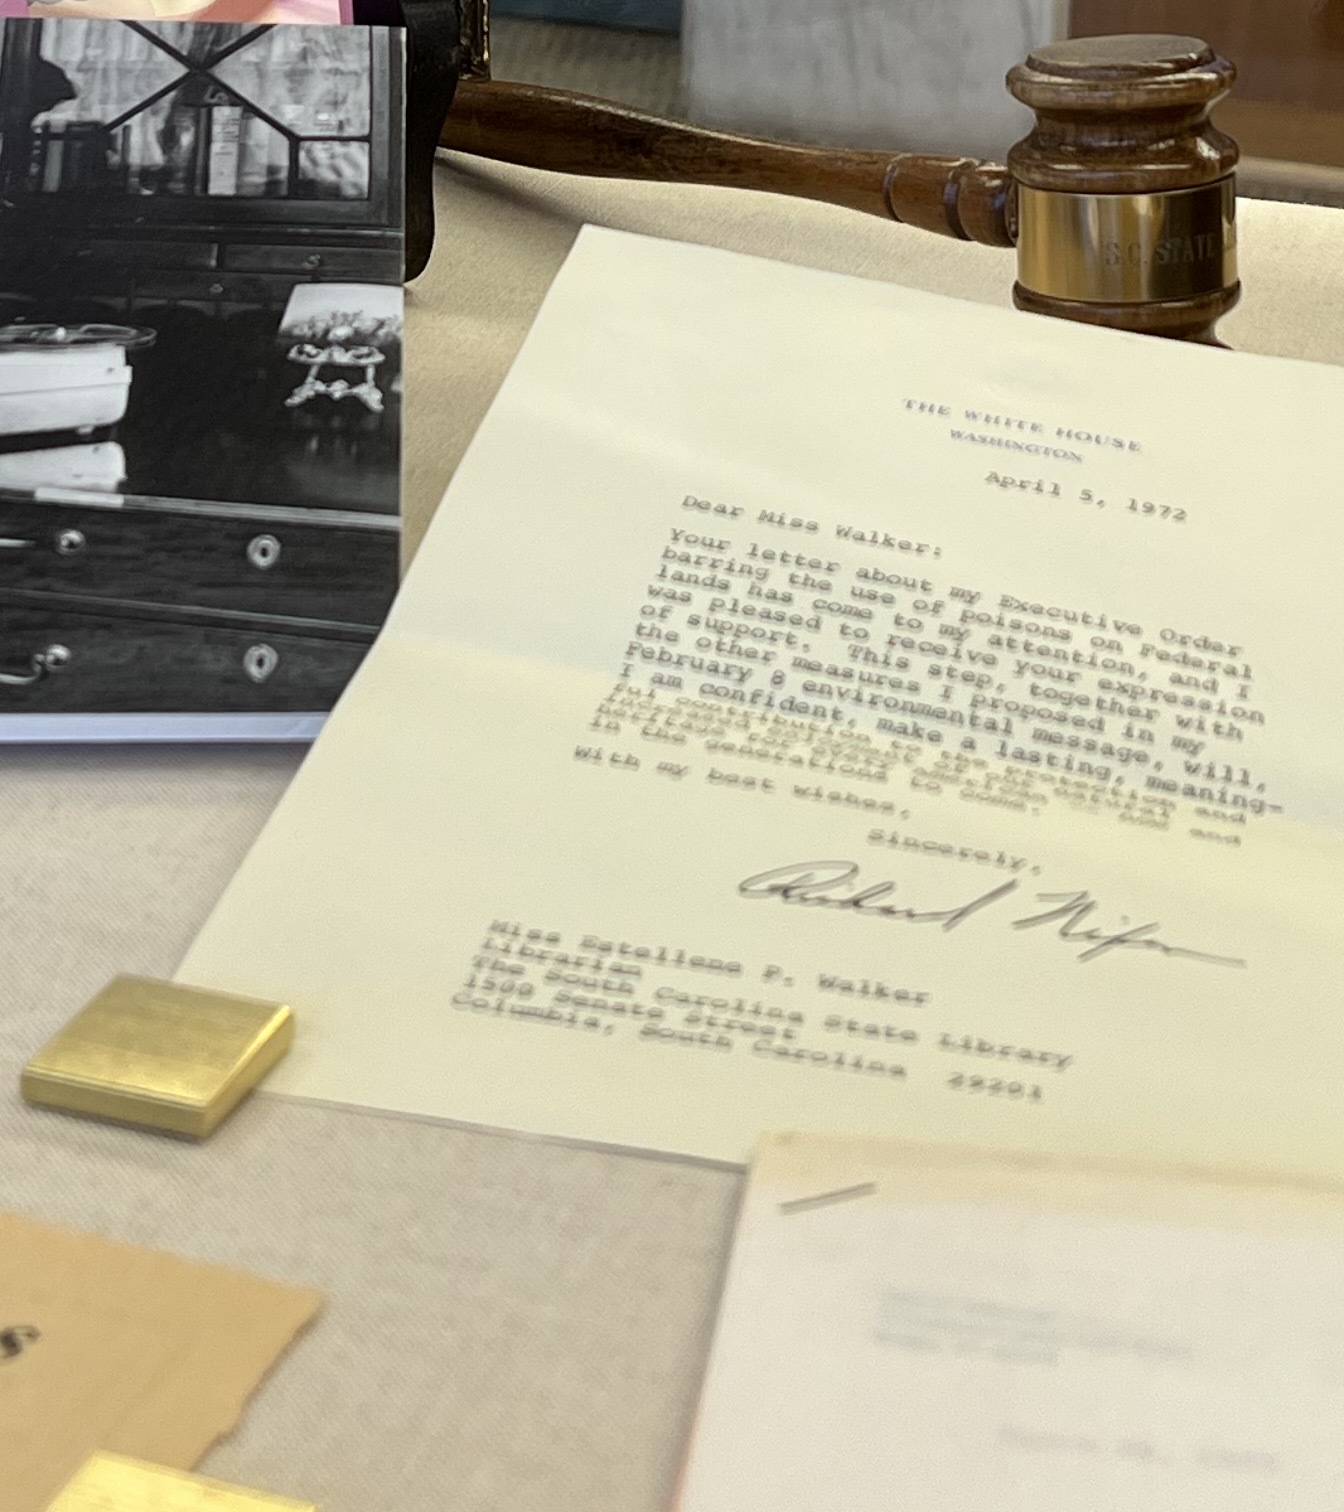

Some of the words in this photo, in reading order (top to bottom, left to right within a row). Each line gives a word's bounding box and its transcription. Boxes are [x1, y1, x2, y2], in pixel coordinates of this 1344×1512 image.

[902, 397, 951, 417] THE
[964, 409, 1044, 435] WHITE
[1055, 426, 1142, 454] HOUSE
[949, 429, 1084, 464] WASHINGTON
[682, 495, 742, 521] Dear
[757, 510, 819, 533] Miss
[835, 524, 942, 558] Walker:
[985, 470, 1061, 497] April
[1078, 488, 1108, 509] 5,
[1126, 497, 1188, 524] 1972
[647, 584, 692, 604] was
[707, 596, 822, 631] pleased
[838, 622, 870, 641] to
[886, 633, 997, 668] receive
[1013, 659, 1082, 684] your
[1097, 677, 1265, 726] expression
[657, 565, 731, 590] lands
[746, 583, 794, 603] has
[811, 598, 874, 620] come
[893, 612, 923, 631] to
[937, 622, 971, 641] my
[987, 634, 1148, 682] attention,
[1168, 671, 1220, 695] and
[661, 545, 769, 581] barring
[787, 571, 833, 592] the
[851, 585, 896, 605] use
[912, 597, 945, 614] of
[958, 608, 1073, 642] poisons
[1089, 635, 1123, 653] on
[1139, 642, 1253, 680] Federal
[670, 527, 731, 552] Your
[746, 542, 840, 573] letter
[855, 565, 933, 592] about
[948, 585, 981, 605] my
[998, 593, 1143, 637] Executive
[1159, 627, 1243, 658] Order
[626, 641, 752, 683] February
[770, 670, 786, 688] 8
[801, 680, 1013, 737] environmental
[1031, 727, 1163, 772] message,
[1183, 759, 1266, 794] will,
[635, 622, 680, 643] the
[695, 636, 777, 665] other
[790, 655, 921, 693] measures
[970, 692, 1106, 734] proposed
[1122, 725, 1155, 744] in
[1170, 735, 1205, 756] my
[639, 604, 674, 620] of
[686, 612, 812, 653] support.
[847, 644, 910, 671] This
[927, 662, 1005, 694] step,
[1029, 682, 1159, 723] together
[1175, 713, 1244, 742] with
[573, 744, 641, 771] With
[655, 759, 690, 779] my
[651, 671, 683, 689] am
[698, 681, 858, 729] confident,
[876, 715, 944, 743] make
[960, 736, 977, 751] a
[996, 740, 1126, 786] lasting,
[1144, 775, 1284, 815] meaning-
